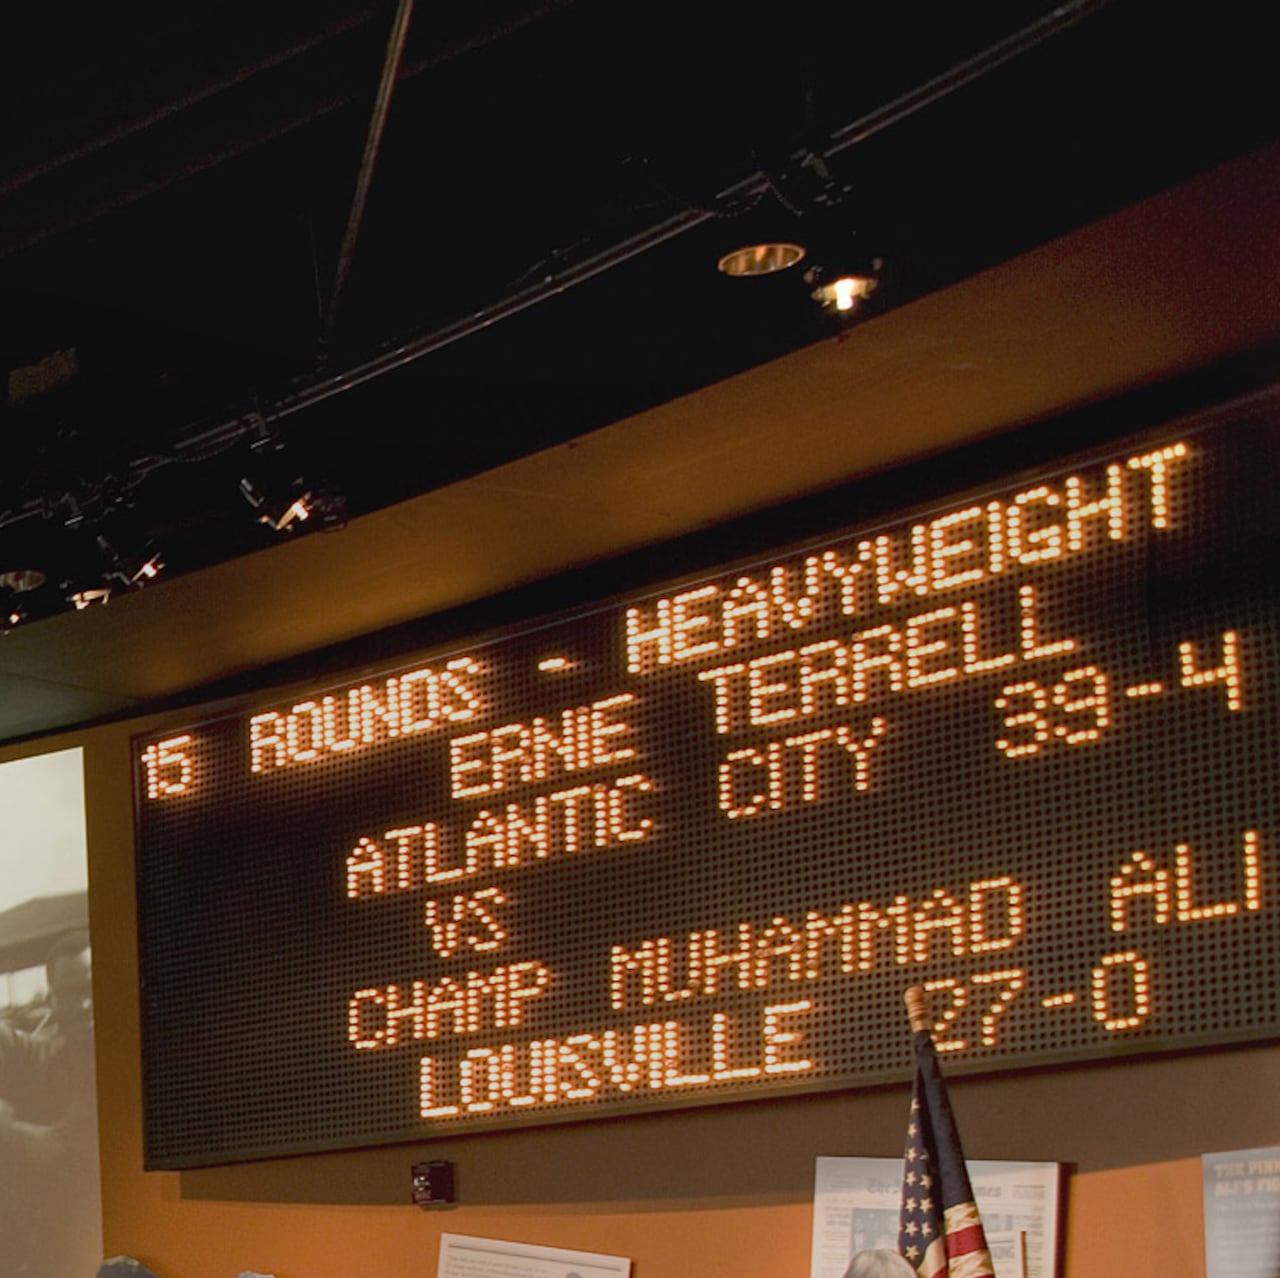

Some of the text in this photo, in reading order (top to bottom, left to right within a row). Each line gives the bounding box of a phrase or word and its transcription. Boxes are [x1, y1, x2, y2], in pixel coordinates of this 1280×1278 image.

[139, 733, 194, 801] 15
[249, 655, 487, 775] ROUNDS
[624, 439, 1191, 676] HEAVYWEIGHT
[449, 586, 1077, 803] ERNIE TERRELL
[345, 629, 1246, 901] ATLANTIC CITY 39-4
[347, 828, 1263, 1053] CHAMP MUHAMMAD ALI
[425, 886, 508, 961] VS
[418, 949, 1152, 1121] LOUISVILLE 27-0
